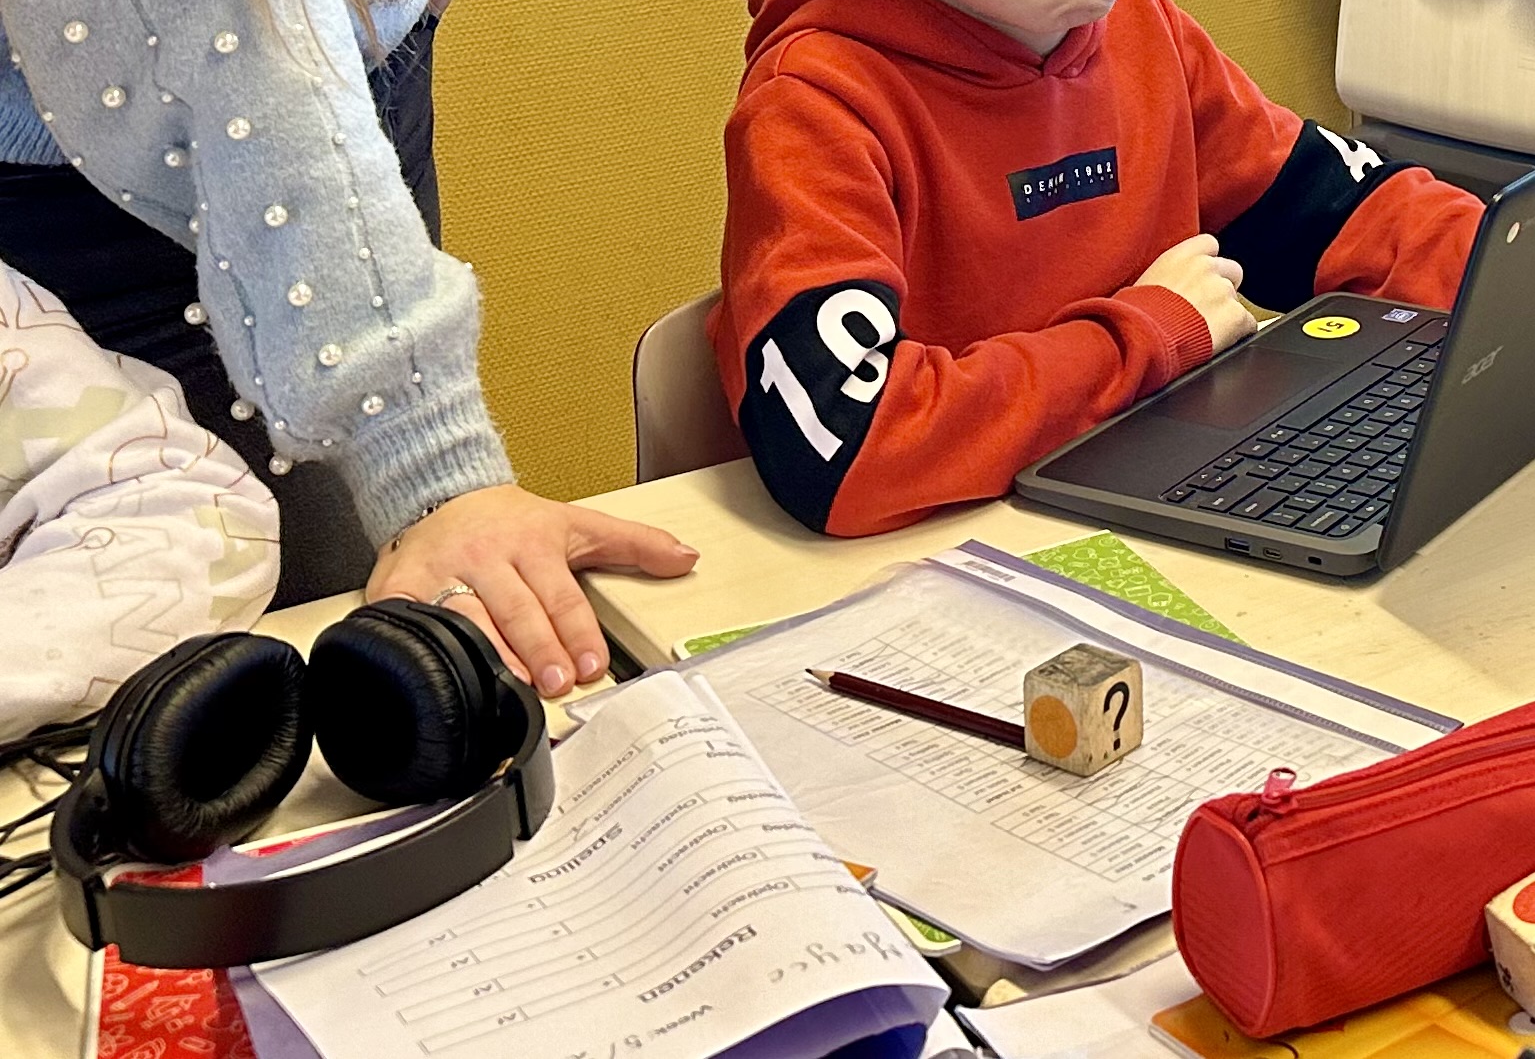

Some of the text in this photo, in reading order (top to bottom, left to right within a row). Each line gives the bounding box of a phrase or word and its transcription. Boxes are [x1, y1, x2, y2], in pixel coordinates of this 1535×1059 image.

[1461, 345, 1504, 384] acer
[527, 822, 623, 884] Spelling
[637, 925, 757, 1003] Rekenen
